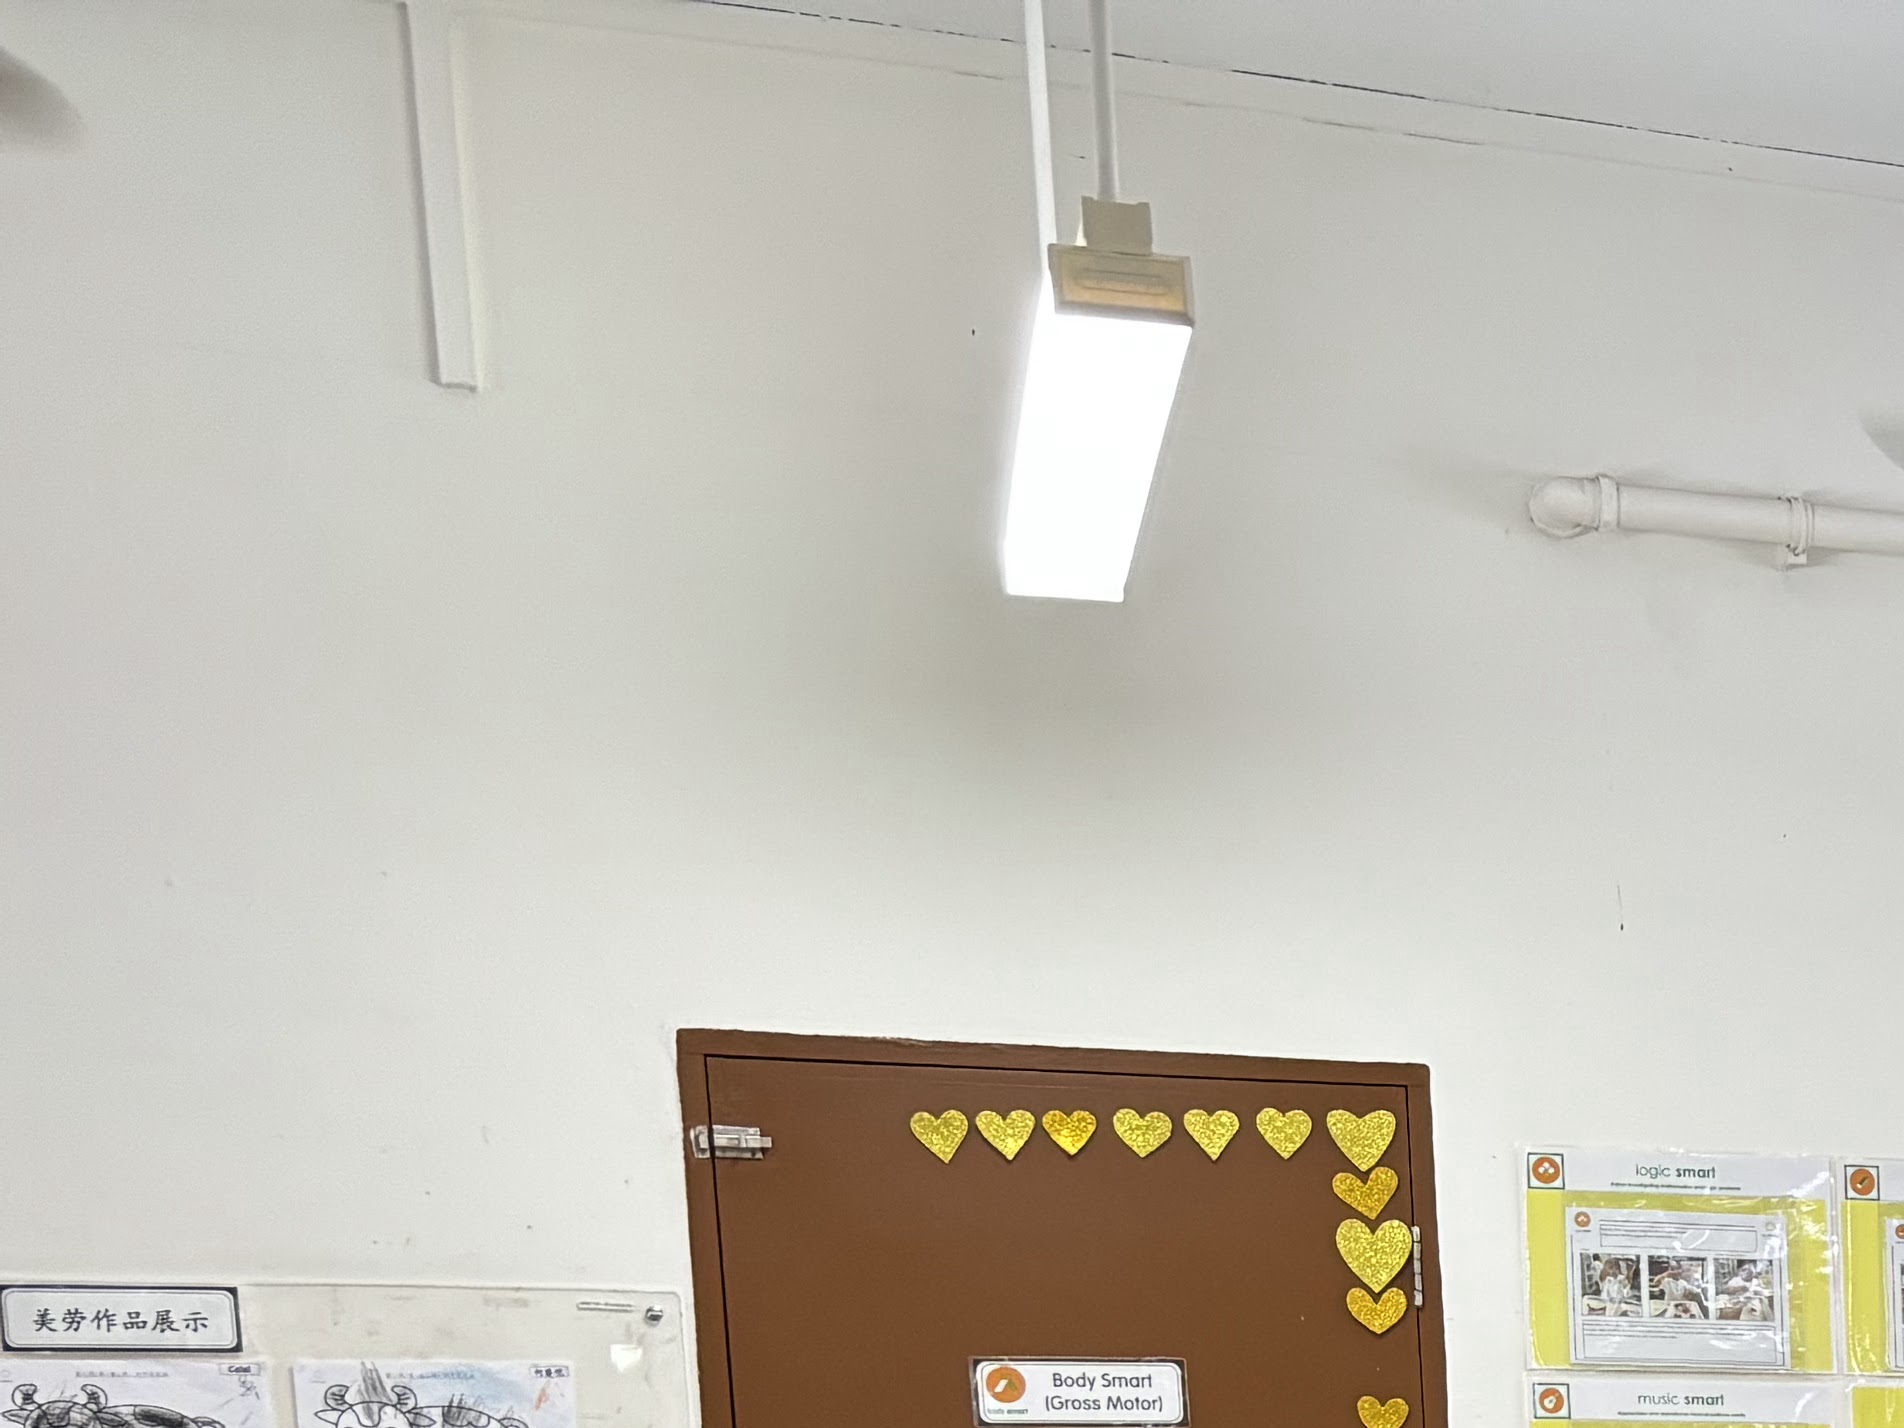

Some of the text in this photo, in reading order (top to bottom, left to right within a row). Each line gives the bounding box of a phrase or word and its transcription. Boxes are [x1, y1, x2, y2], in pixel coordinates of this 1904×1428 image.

[1635, 1163, 1716, 1180] logic smart
[32, 1308, 209, 1334] 美劳作品展示
[1052, 1372, 1153, 1390] Body Smart
[1045, 1396, 1163, 1413] (Gross Motor)
[1637, 1392, 1724, 1407] music smart
